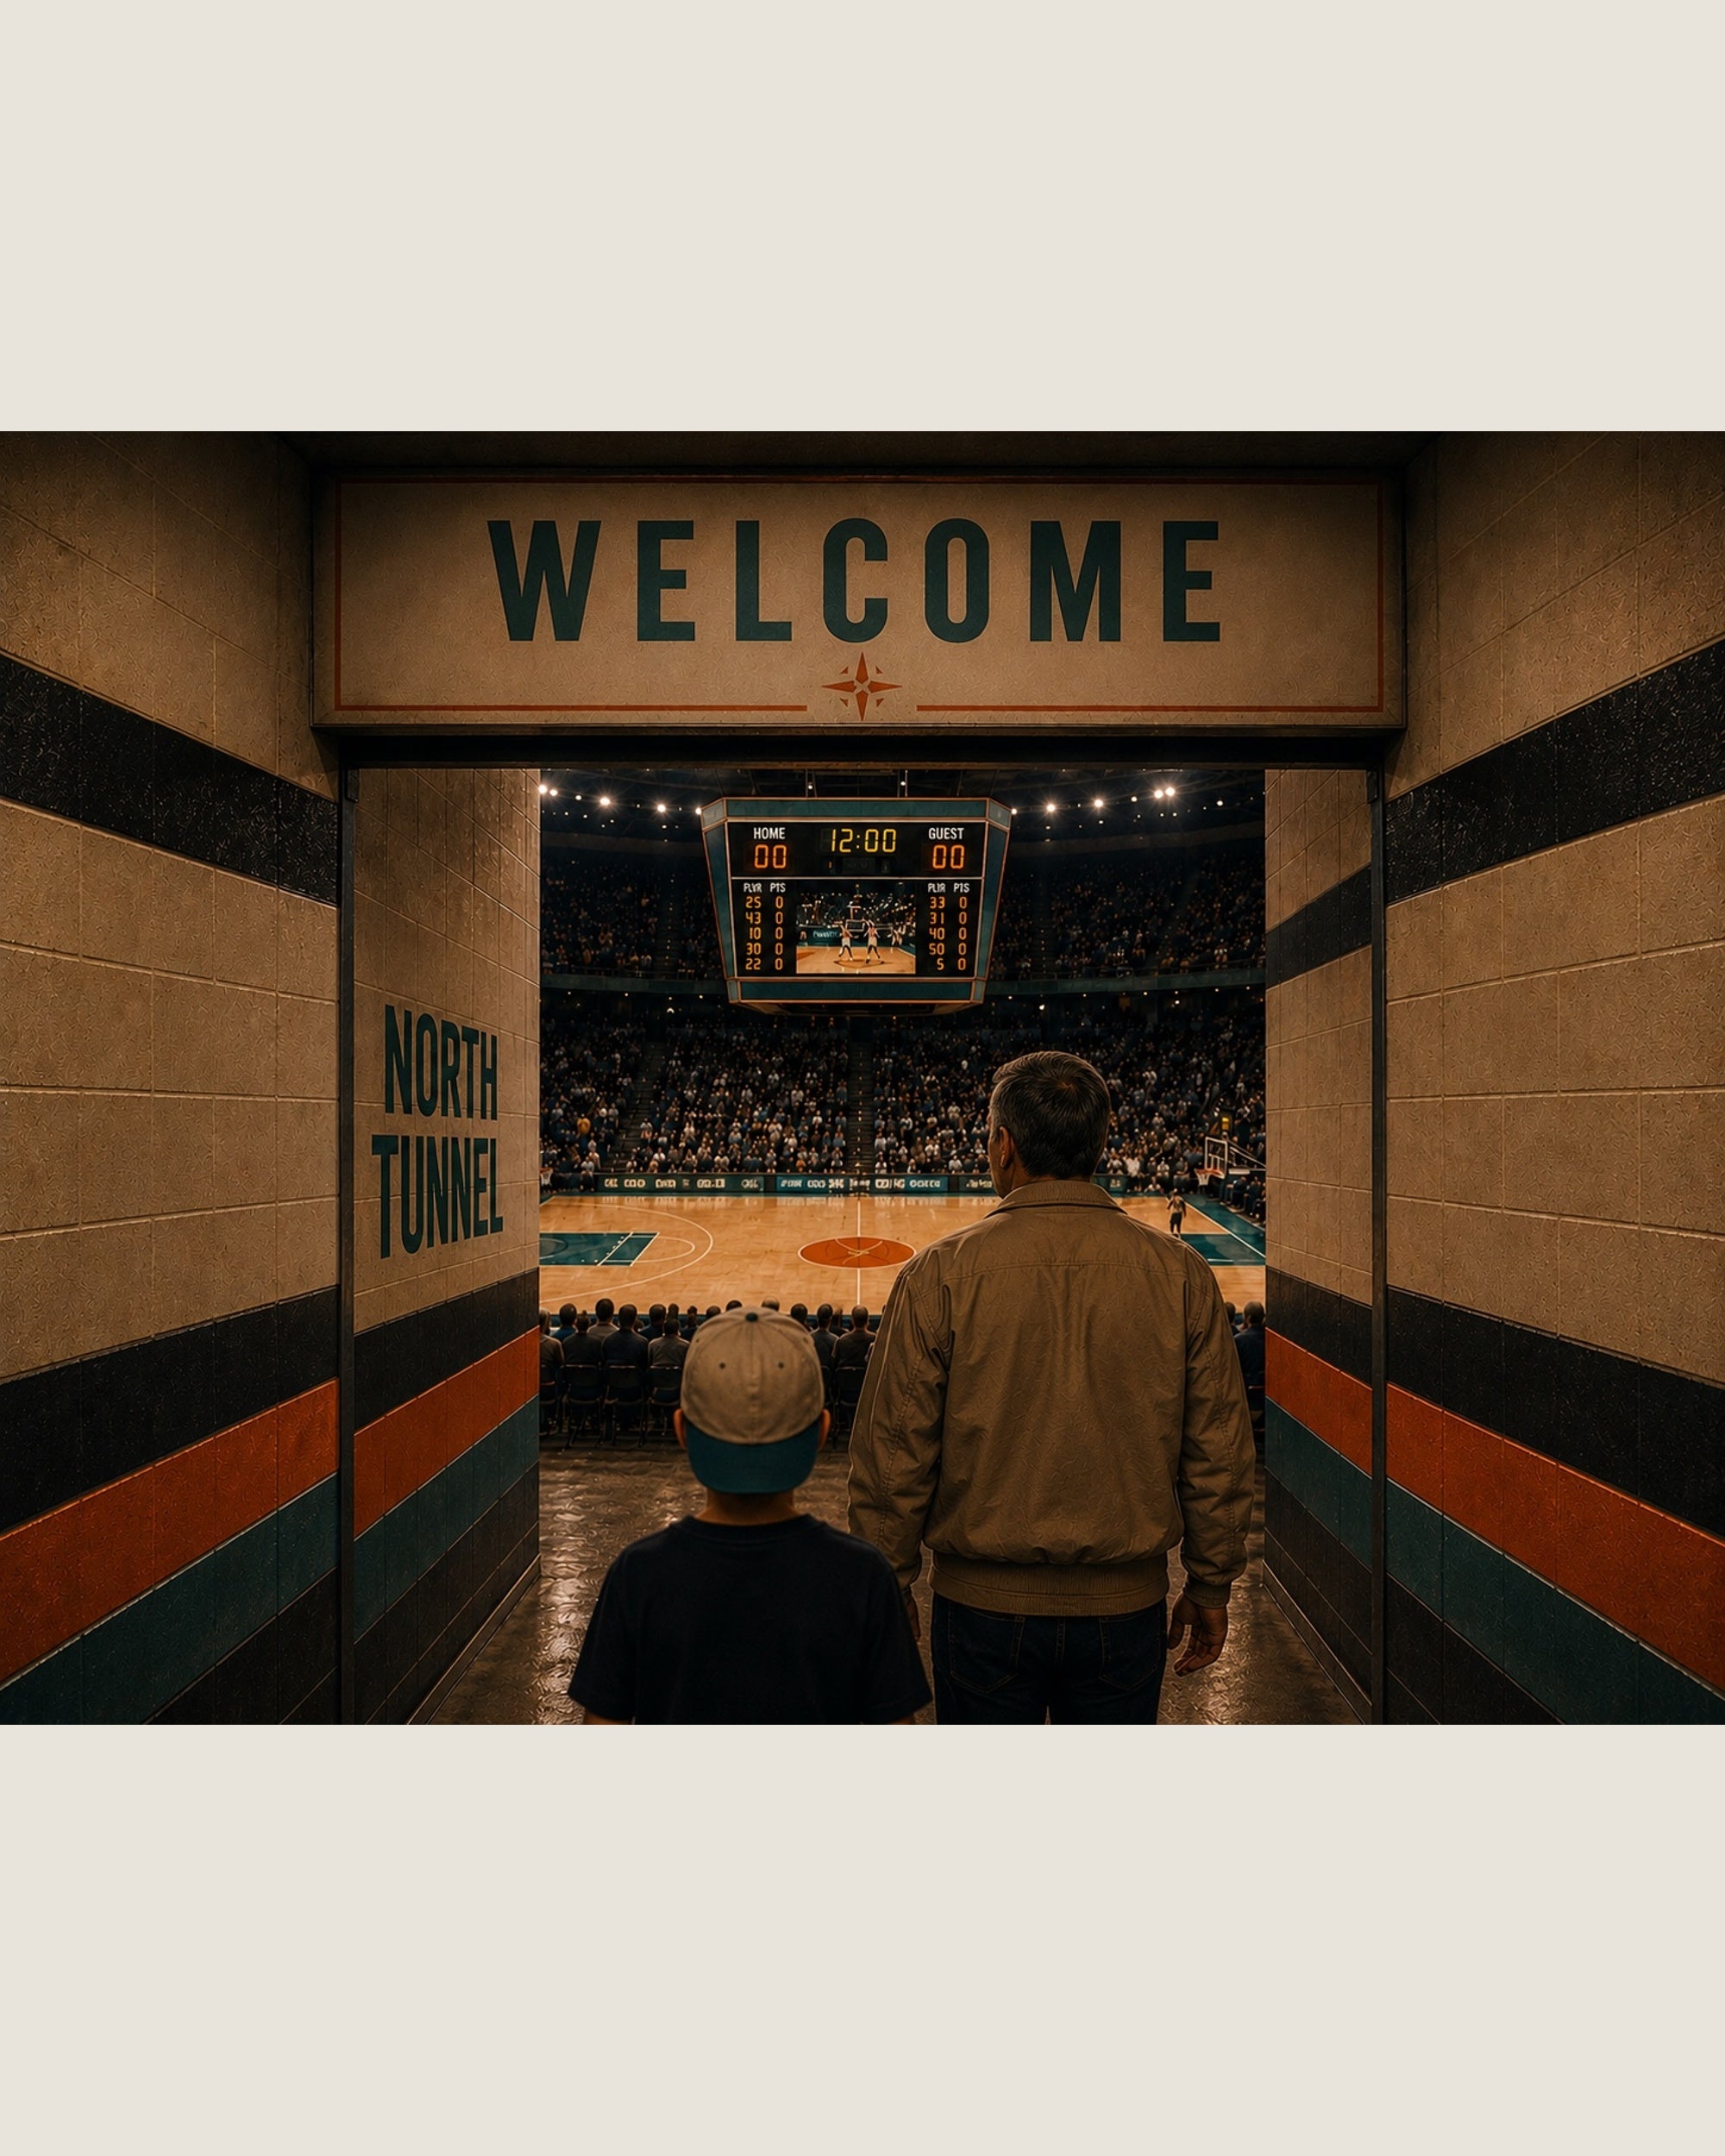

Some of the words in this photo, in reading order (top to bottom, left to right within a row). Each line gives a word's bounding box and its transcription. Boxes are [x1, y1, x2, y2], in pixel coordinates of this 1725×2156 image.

[486, 517, 1220, 643] WELCOME
[753, 827, 786, 839] HOME
[928, 827, 964, 839] GUEST
[831, 828, 897, 852] 12:00
[754, 843, 787, 868] 00
[932, 844, 965, 868] 00
[769, 882, 786, 893] PTS
[745, 895, 762, 908] 25
[775, 895, 784, 908] 0
[930, 896, 945, 908] 33
[959, 896, 968, 908] 0
[745, 912, 762, 924] 43
[775, 911, 783, 924] 0
[930, 912, 944, 924] 31
[958, 911, 968, 924] 0
[750, 926, 762, 939] 10
[775, 926, 783, 939] 0
[929, 927, 945, 940] 40
[958, 927, 967, 940] 0
[746, 942, 762, 955] 30
[775, 943, 783, 955] 0
[928, 943, 945, 955] 50
[958, 942, 967, 955] 0
[745, 957, 762, 969] 22
[775, 957, 783, 969] 0
[937, 957, 944, 970] 5
[957, 957, 967, 969] 0
[385, 1004, 498, 1120] NORTH
[371, 1134, 504, 1259] TUNNEL
